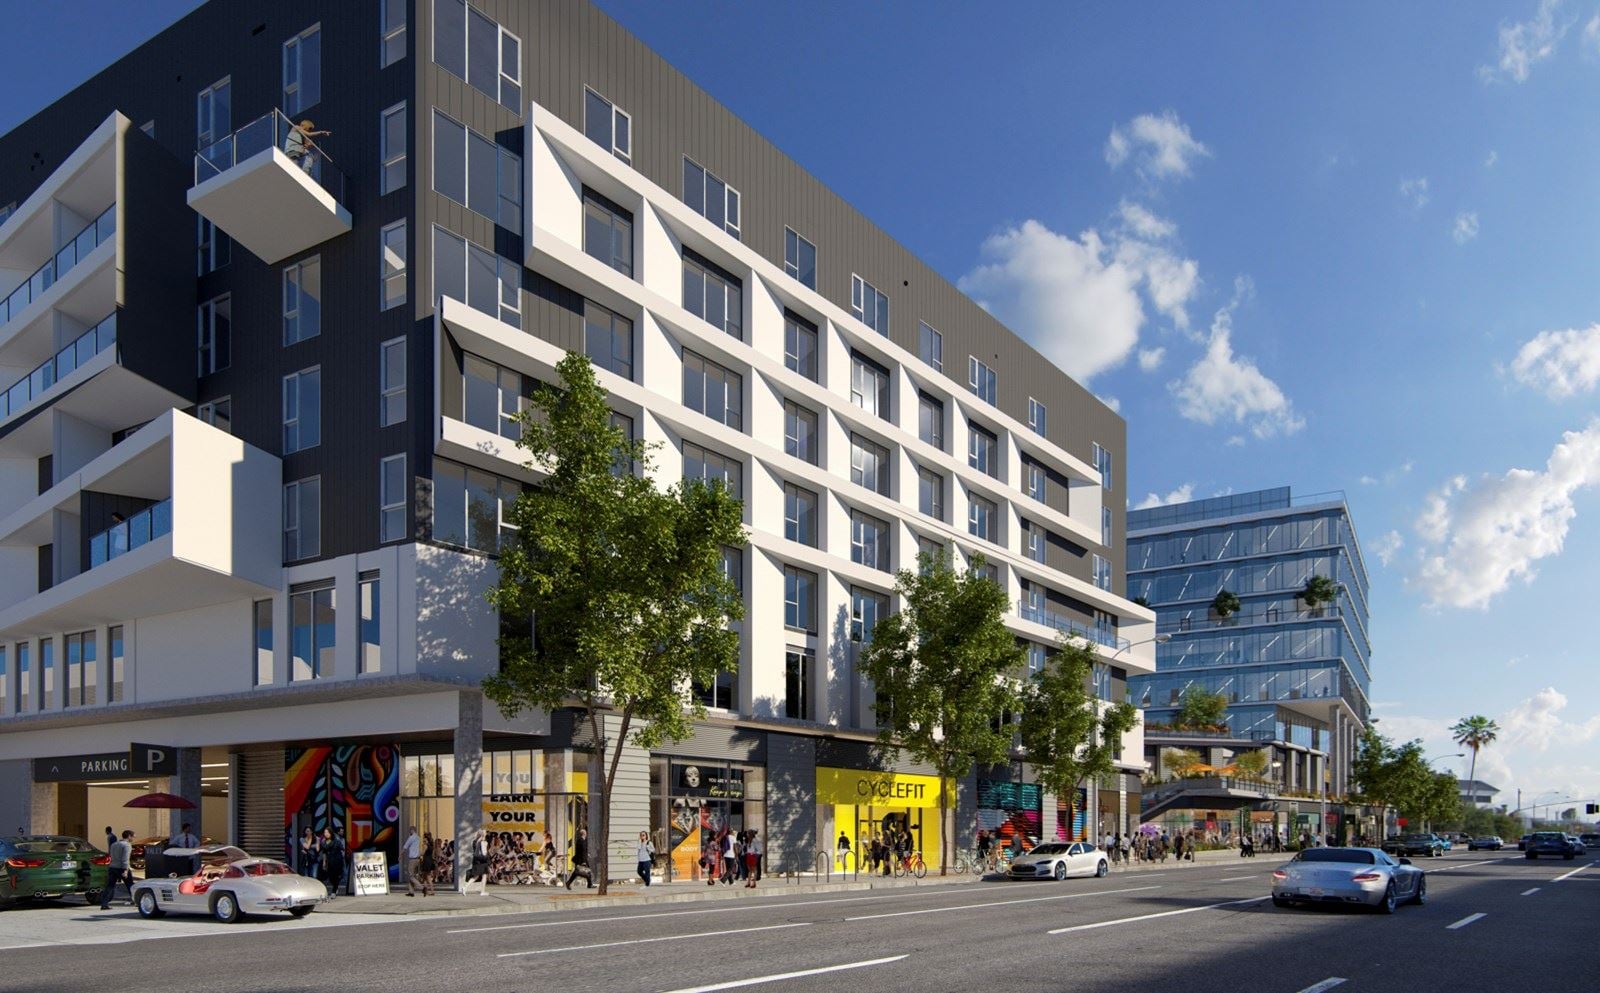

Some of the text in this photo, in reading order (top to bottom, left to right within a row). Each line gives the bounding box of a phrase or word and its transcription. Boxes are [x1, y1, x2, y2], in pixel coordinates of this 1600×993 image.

[147, 749, 164, 771] P
[81, 759, 128, 773] PARKING
[496, 773, 529, 784] YOU
[857, 779, 926, 799] CYCLEFIT
[490, 795, 535, 803] EARN
[489, 811, 536, 822] YOUR
[356, 864, 383, 872] VALET
